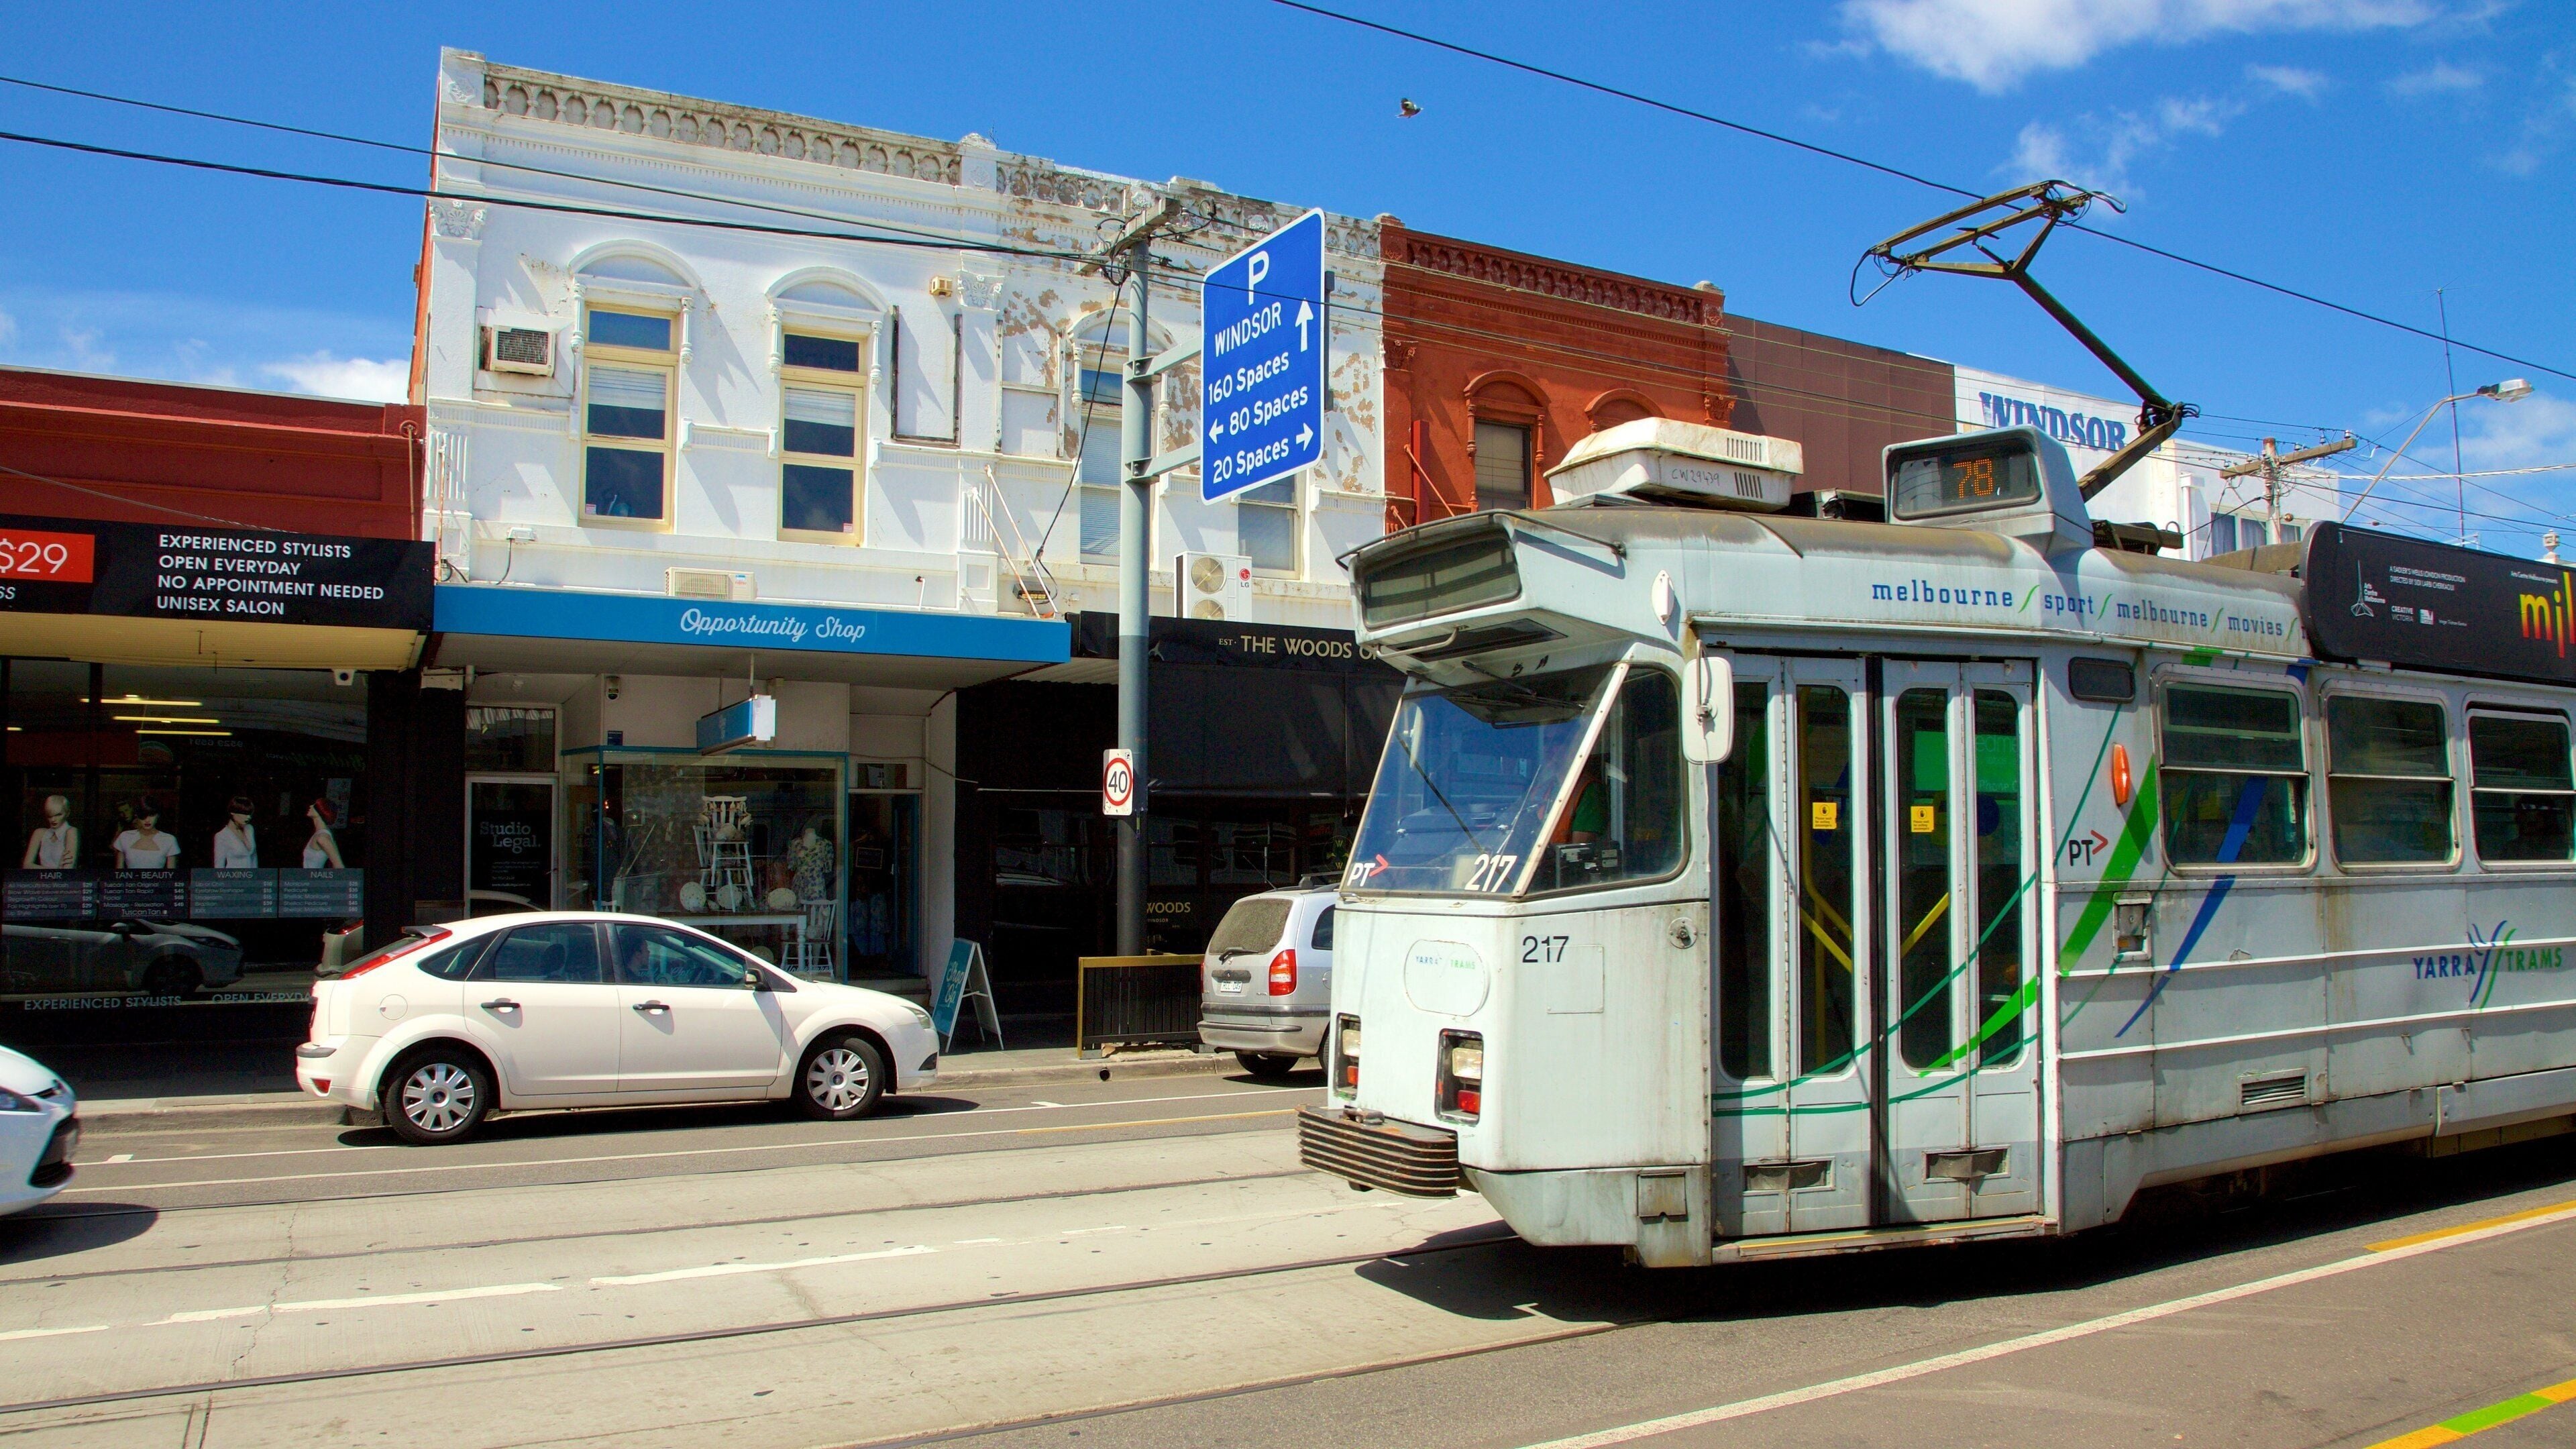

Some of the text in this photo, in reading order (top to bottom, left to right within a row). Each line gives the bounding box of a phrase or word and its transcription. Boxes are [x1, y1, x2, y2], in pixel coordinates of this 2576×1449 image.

[1248, 250, 1269, 305] P
[1215, 302, 1281, 357] WINDSOR
[1208, 352, 1289, 405] 160 Spaces
[1230, 386, 1308, 435] 80 Spaces
[1979, 392, 2126, 452] WINDSOR
[1213, 438, 1289, 484] 20 Spaces
[1953, 458, 1994, 498] 78
[160, 534, 352, 559] EXPERIENCED STYLISTS
[159, 554, 301, 576] OPEN EVERYDAY
[158, 574, 384, 600] NO APPOINTMENT NEEDED
[156, 595, 285, 616] UNISEX SALON
[1872, 577, 2014, 608] melbourne
[2044, 591, 2094, 617] sport
[2116, 598, 2208, 629] melbourne
[2227, 616, 2282, 636] movies
[2391, 605, 2414, 614] CREATIVE
[680, 607, 865, 642] Opportunity Shop
[1240, 635, 1276, 653] THE
[1283, 637, 1352, 659] WOODS
[1108, 770, 1128, 794] 40
[479, 821, 532, 835] Studio
[2068, 839, 2093, 866] PT
[40, 871, 62, 879] HAIR
[114, 871, 174, 879] TAN BEAUTY
[1347, 863, 1376, 887] PT
[1464, 853, 1517, 893] 217
[1521, 935, 1569, 963] 217
[2412, 947, 2563, 979] YARRA TRAMS
[24, 995, 182, 1011] EXPERIENCED STYLISTS
[211, 993, 249, 1004] OPEN
